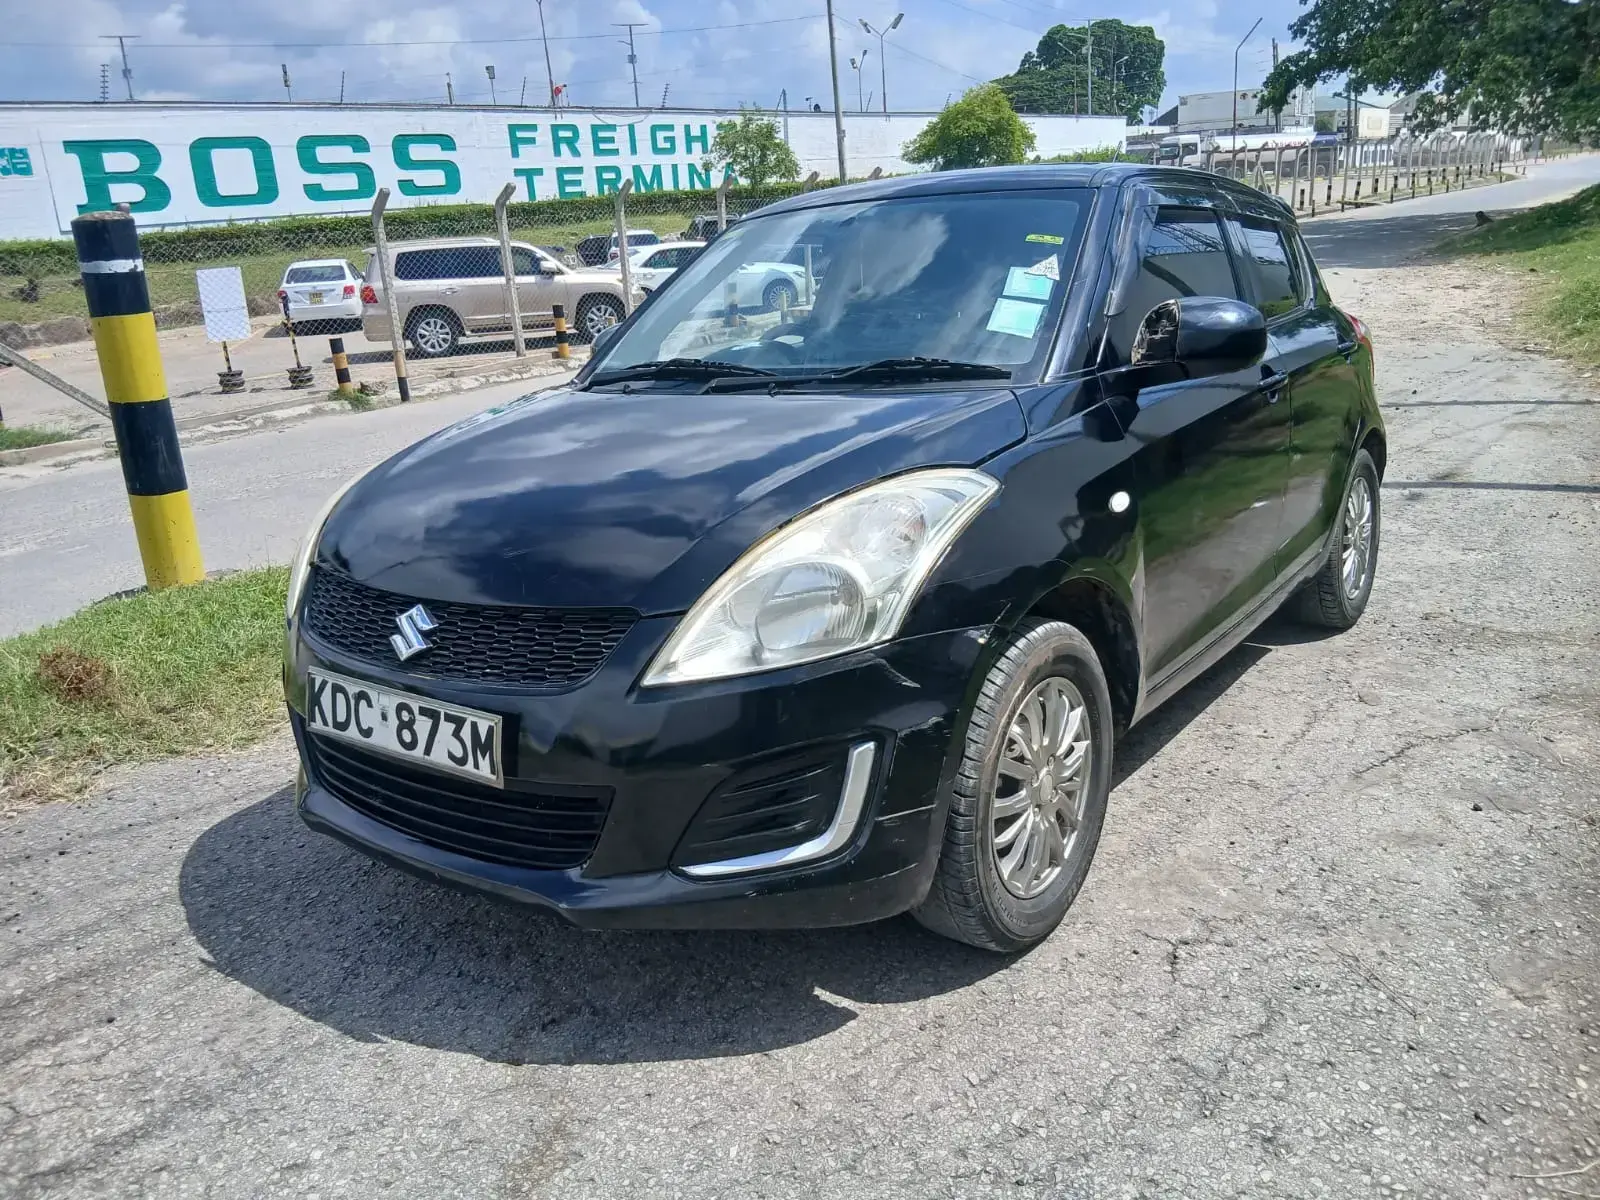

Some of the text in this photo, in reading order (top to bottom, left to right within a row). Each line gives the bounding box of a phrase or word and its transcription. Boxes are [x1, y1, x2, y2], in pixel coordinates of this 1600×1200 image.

[62, 133, 462, 214] BOSS
[513, 162, 742, 201] TERMINA
[308, 675, 497, 775] KDC 873M
